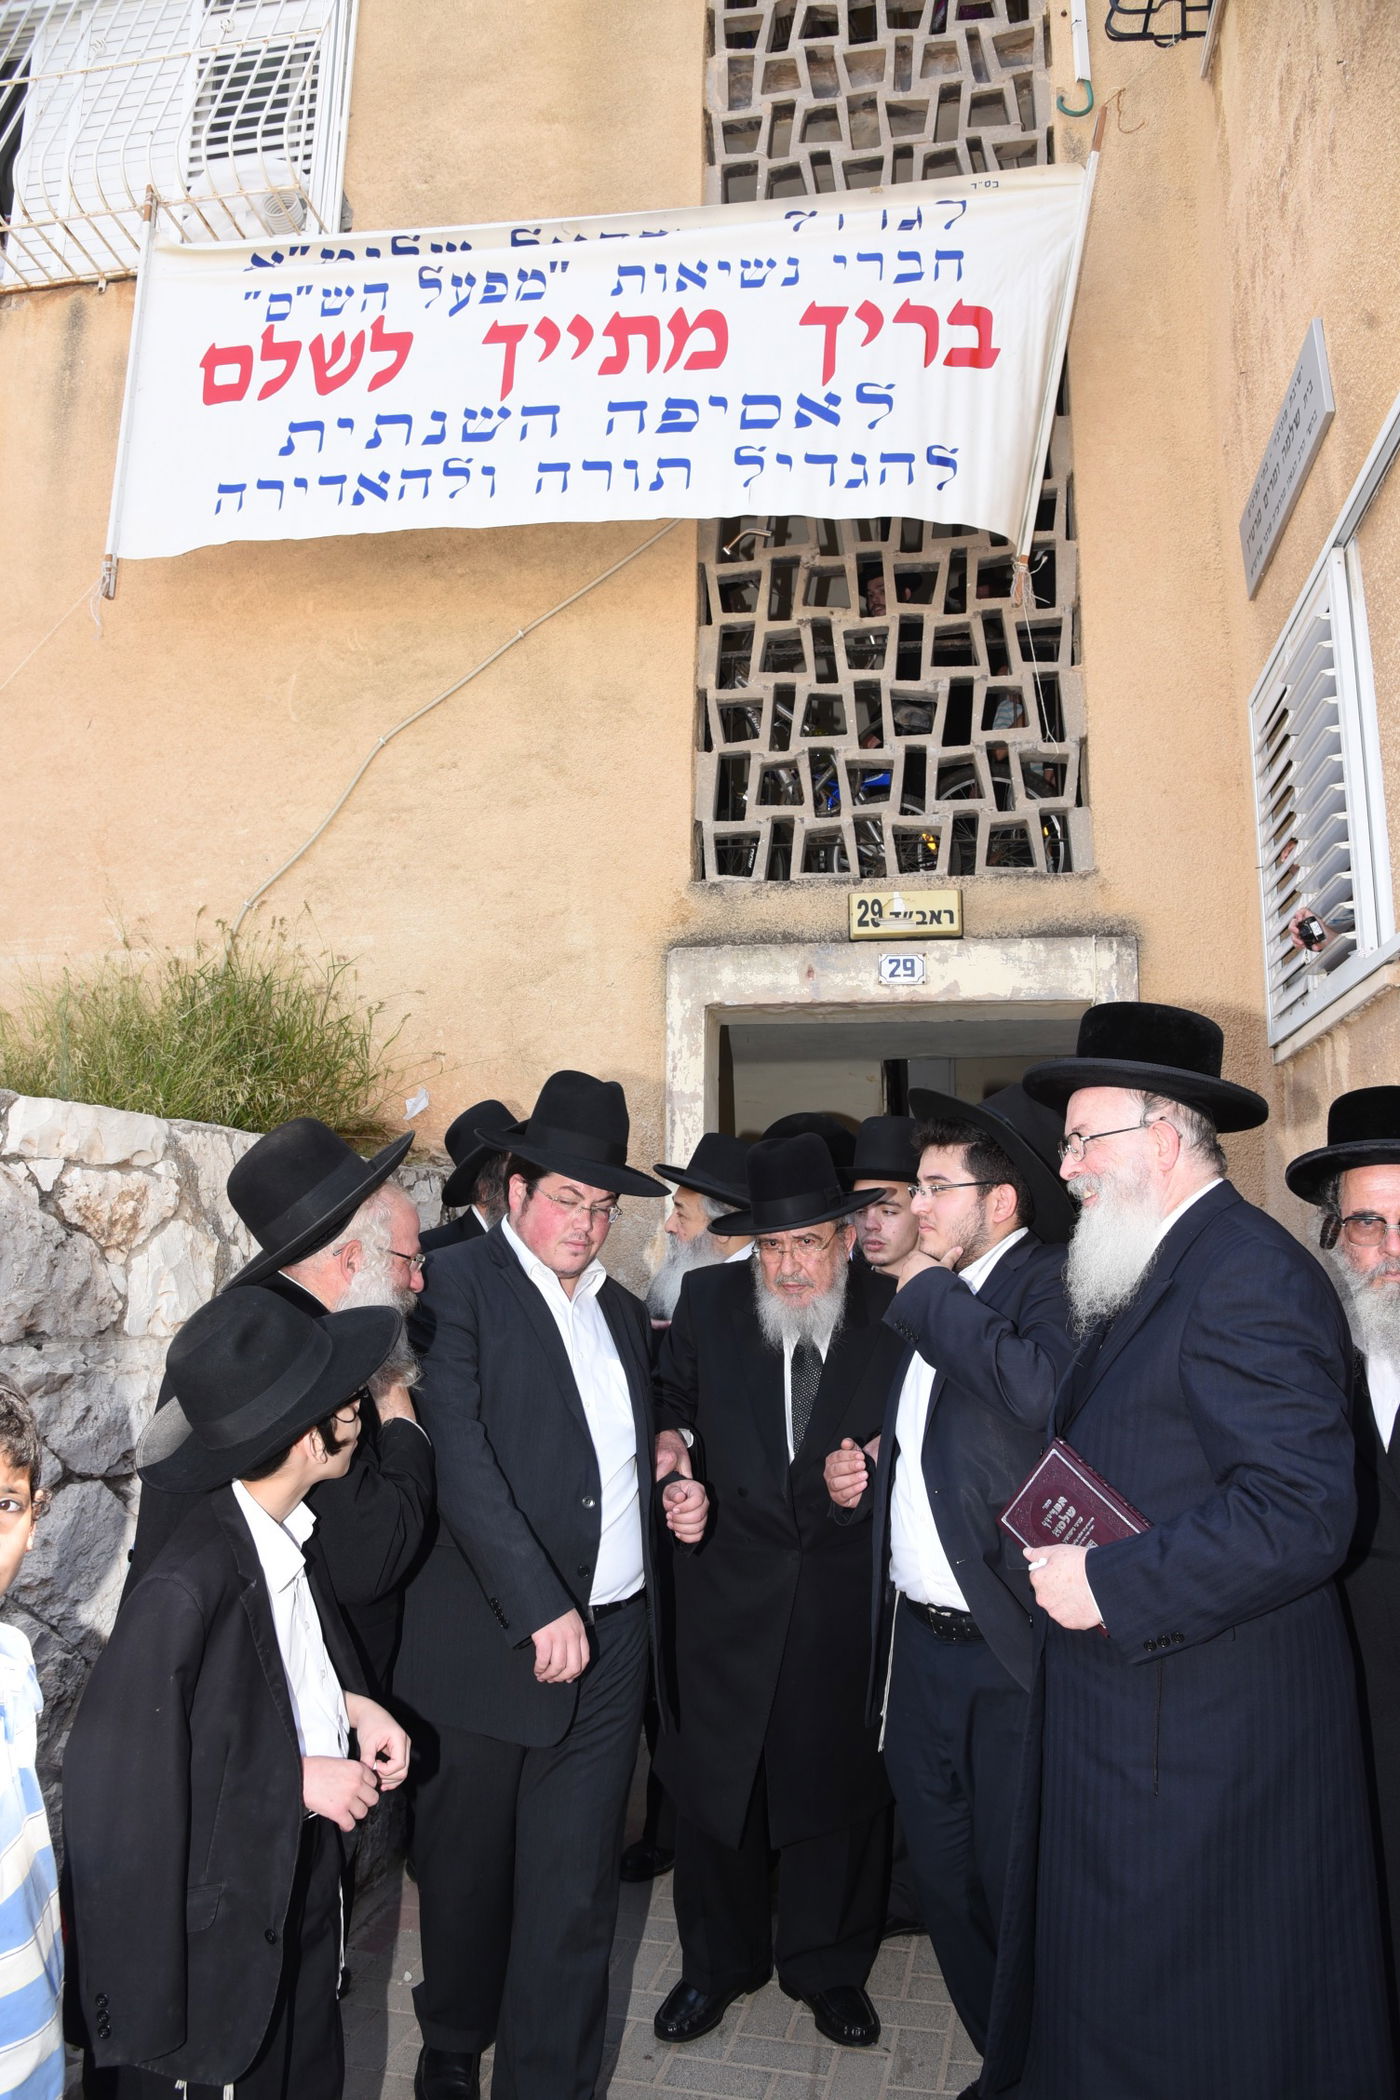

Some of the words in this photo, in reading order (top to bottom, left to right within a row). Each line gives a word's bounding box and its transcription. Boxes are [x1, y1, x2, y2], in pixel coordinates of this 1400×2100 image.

[970, 180, 999, 190] בס"ד
[416, 260, 570, 317] "מפעל
[610, 257, 800, 297] נשיאות
[832, 249, 965, 285] חברי
[199, 315, 414, 406] לשלם
[482, 307, 729, 401] מתייך
[799, 299, 1001, 386] בריך
[277, 404, 561, 457] השנתית
[605, 382, 896, 436] לאסיפה
[1281, 407, 1301, 464] שלמה
[215, 457, 497, 514] ולהאדירה
[535, 457, 692, 494] תורה
[734, 445, 960, 491] להגדיל
[857, 899, 883, 928] 29
[888, 958, 915, 978] 29
[1051, 1505, 1077, 1538] שלמה
